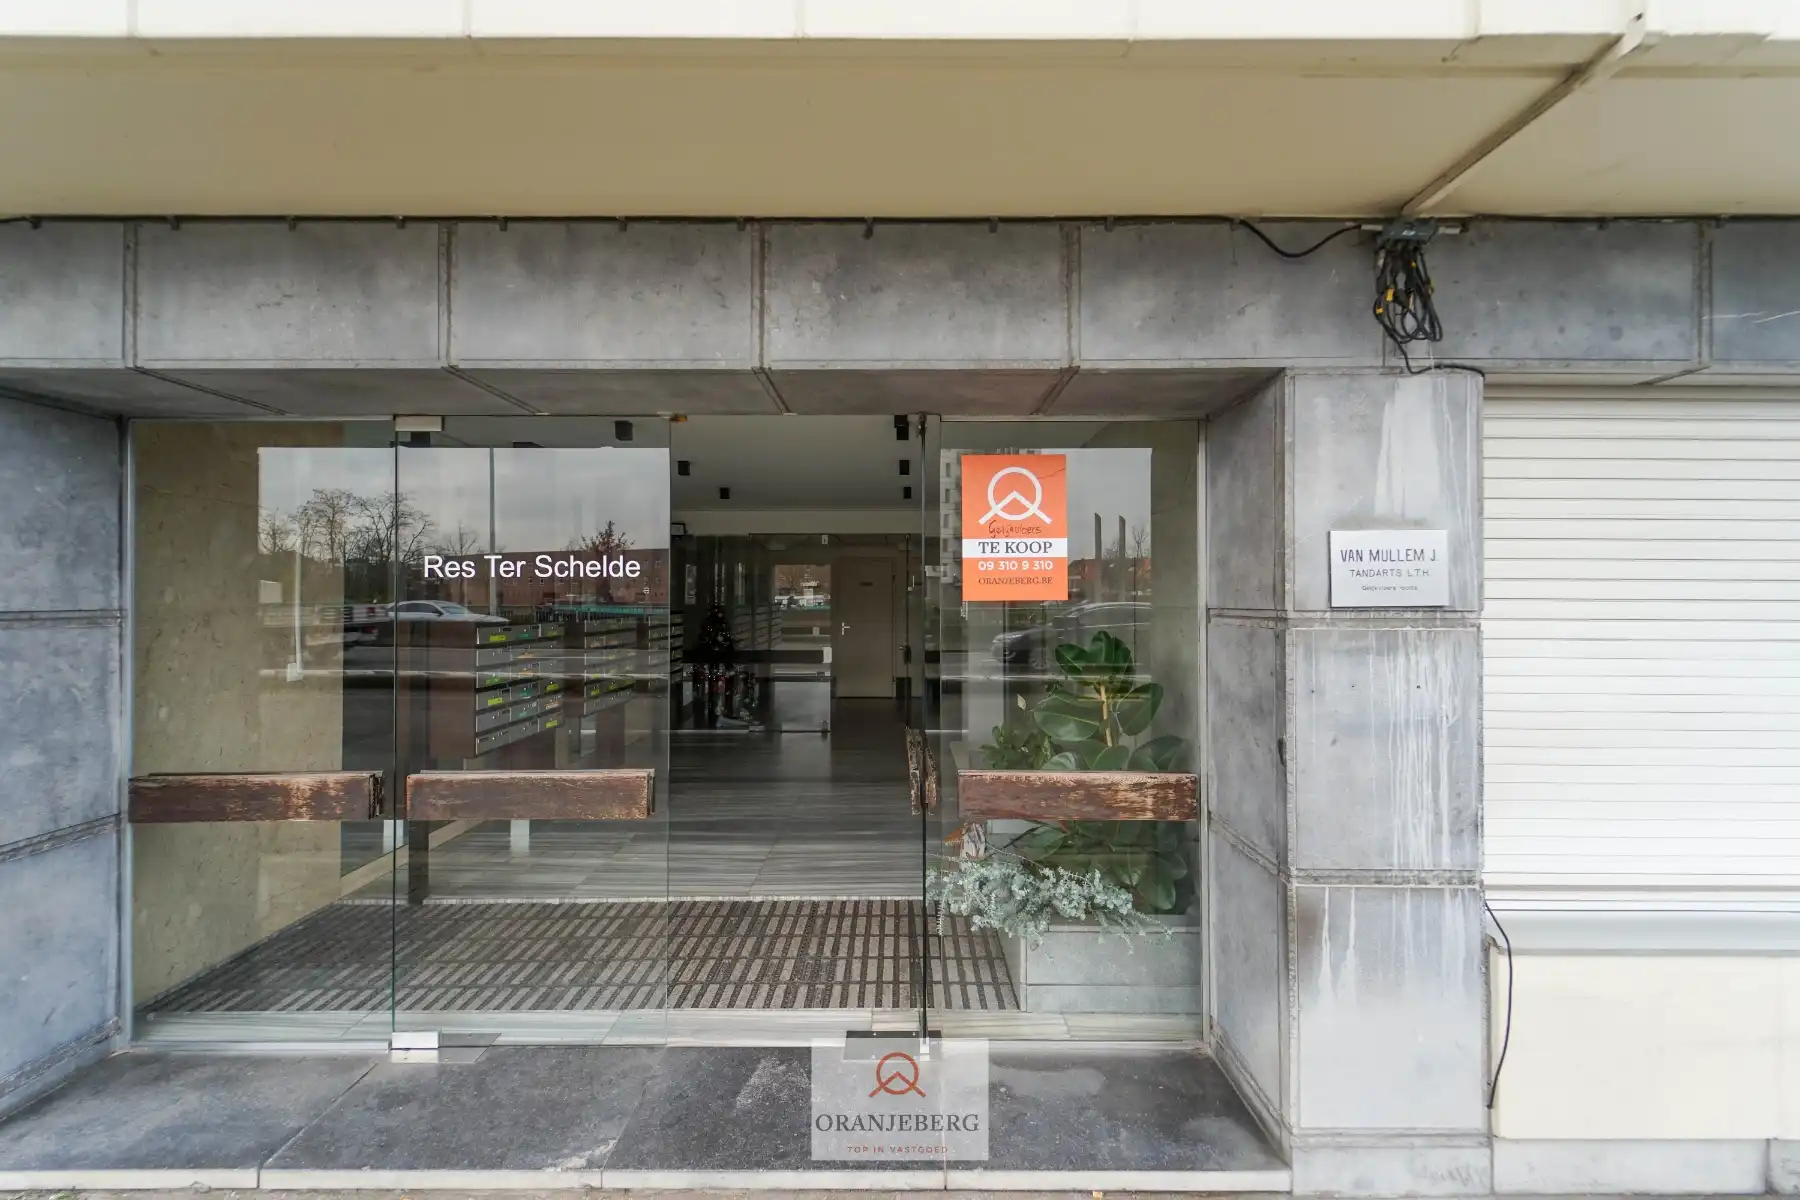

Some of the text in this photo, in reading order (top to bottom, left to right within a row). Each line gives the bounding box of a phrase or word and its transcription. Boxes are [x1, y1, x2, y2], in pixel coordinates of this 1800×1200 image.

[978, 541, 1053, 554] TE KOOP
[1340, 549, 1364, 562] VAN
[1369, 548, 1425, 562] MULLEM
[424, 554, 641, 578] Res Ter Schelde
[978, 560, 1054, 571] 09 310 9 310
[1349, 568, 1404, 578] TANDARTS
[978, 576, 1053, 585] ORANJEBERG.BE
